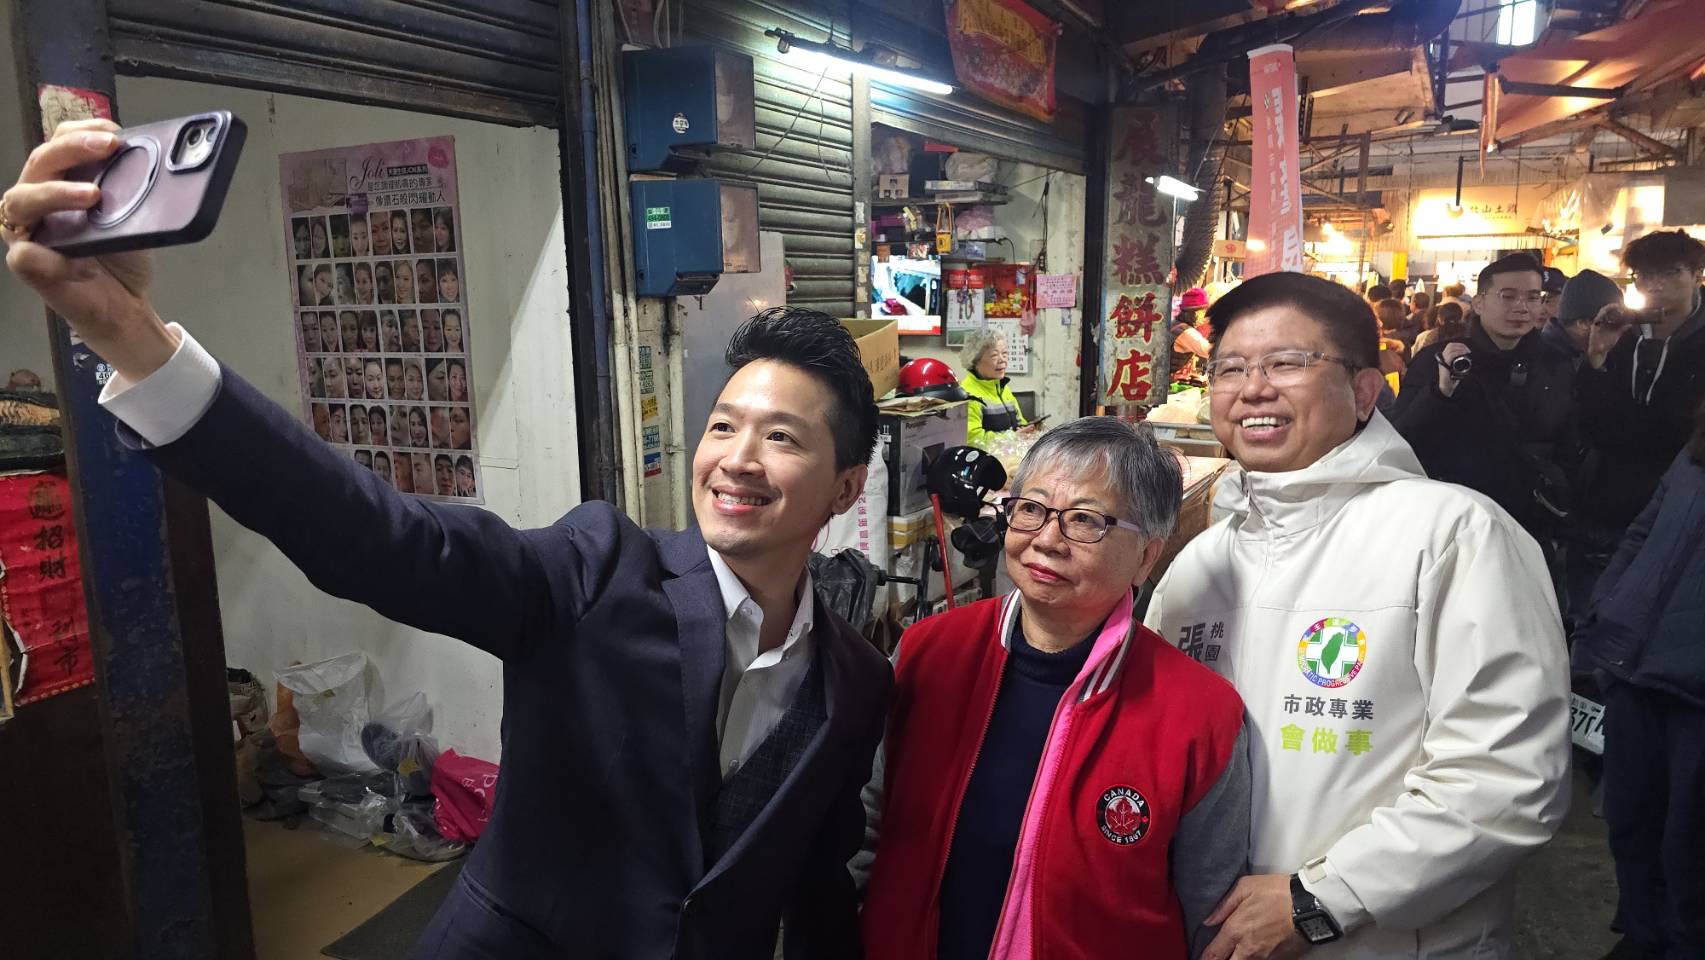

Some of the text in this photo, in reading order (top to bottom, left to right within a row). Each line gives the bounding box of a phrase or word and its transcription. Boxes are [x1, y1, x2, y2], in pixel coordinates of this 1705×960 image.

[350, 157, 385, 189] Joli
[1205, 621, 1224, 662] 桃園
[1284, 694, 1374, 720] 市政專業
[1280, 723, 1374, 756] 會做事
[1103, 788, 1145, 808] CANADA
[1101, 825, 1122, 843] SINCE
